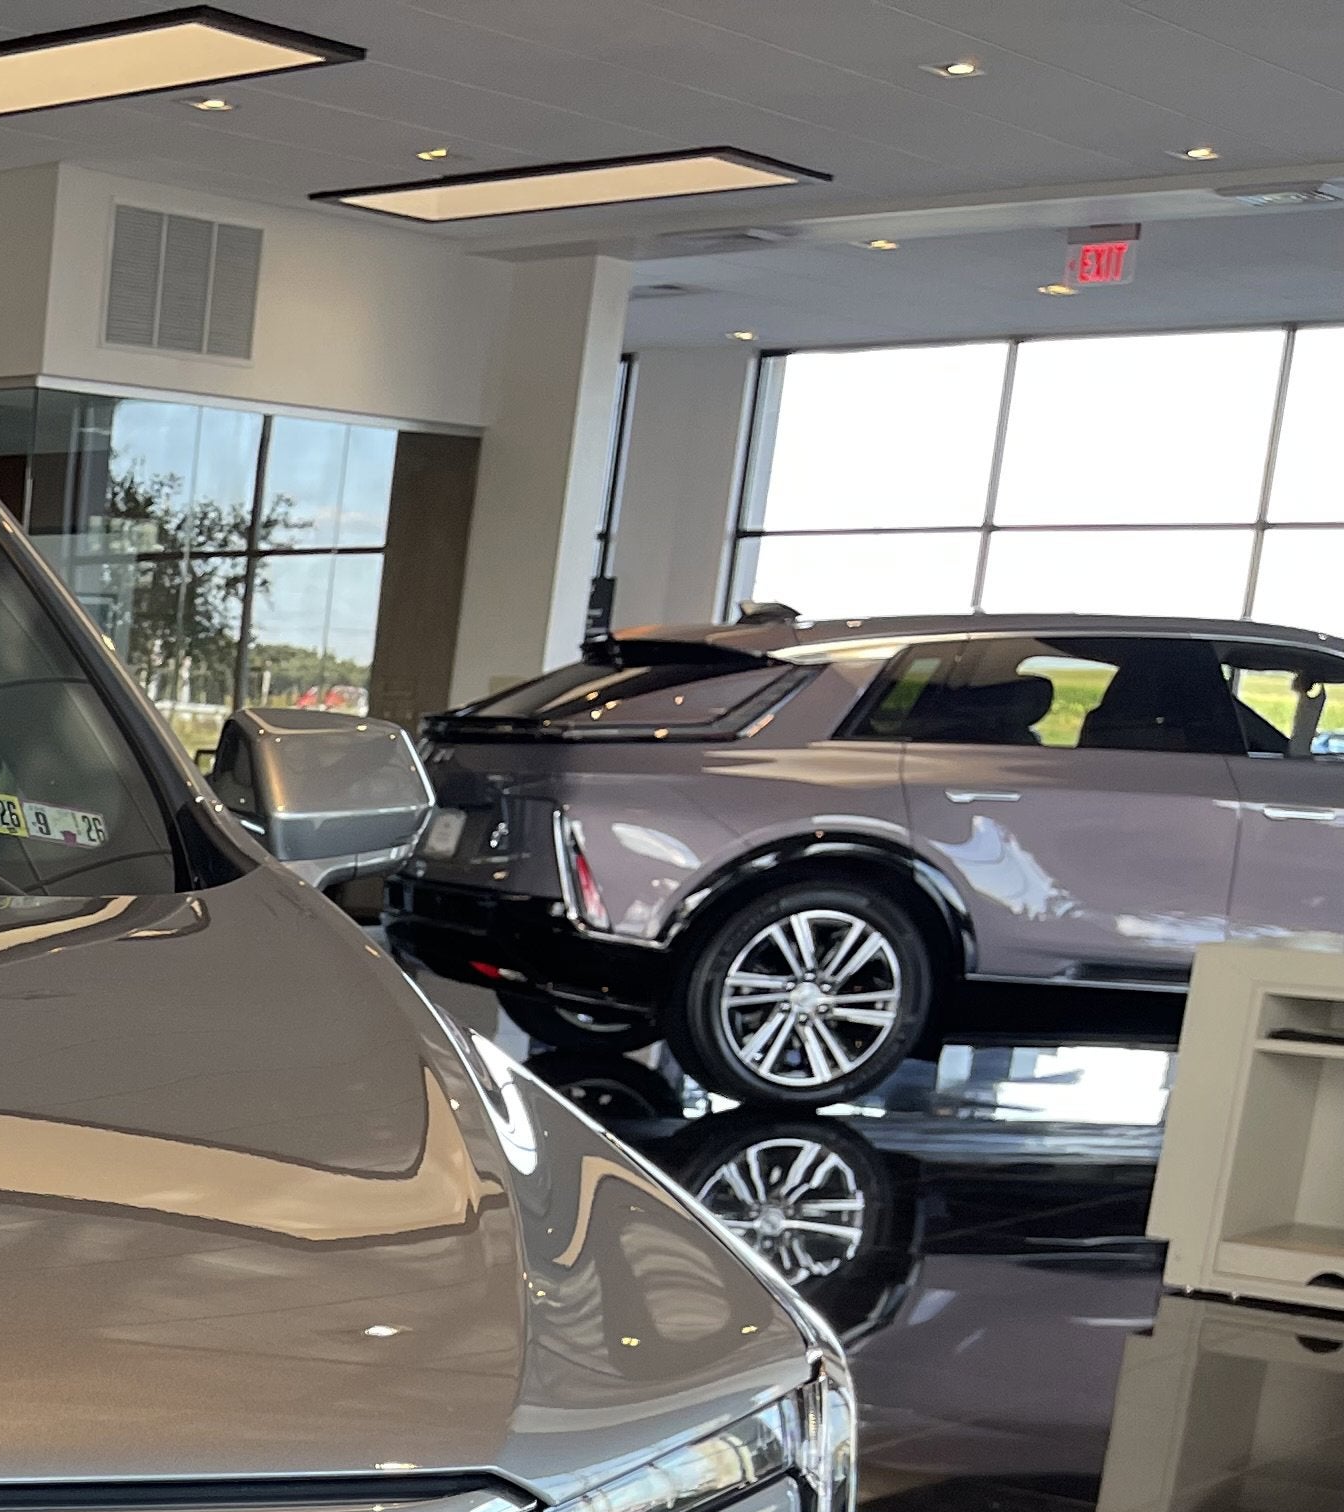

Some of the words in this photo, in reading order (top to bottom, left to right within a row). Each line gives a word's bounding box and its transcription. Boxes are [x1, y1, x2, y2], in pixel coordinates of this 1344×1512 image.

[1078, 242, 1128, 283] EXIT
[35, 811, 51, 836] 9
[82, 815, 106, 843] 26
